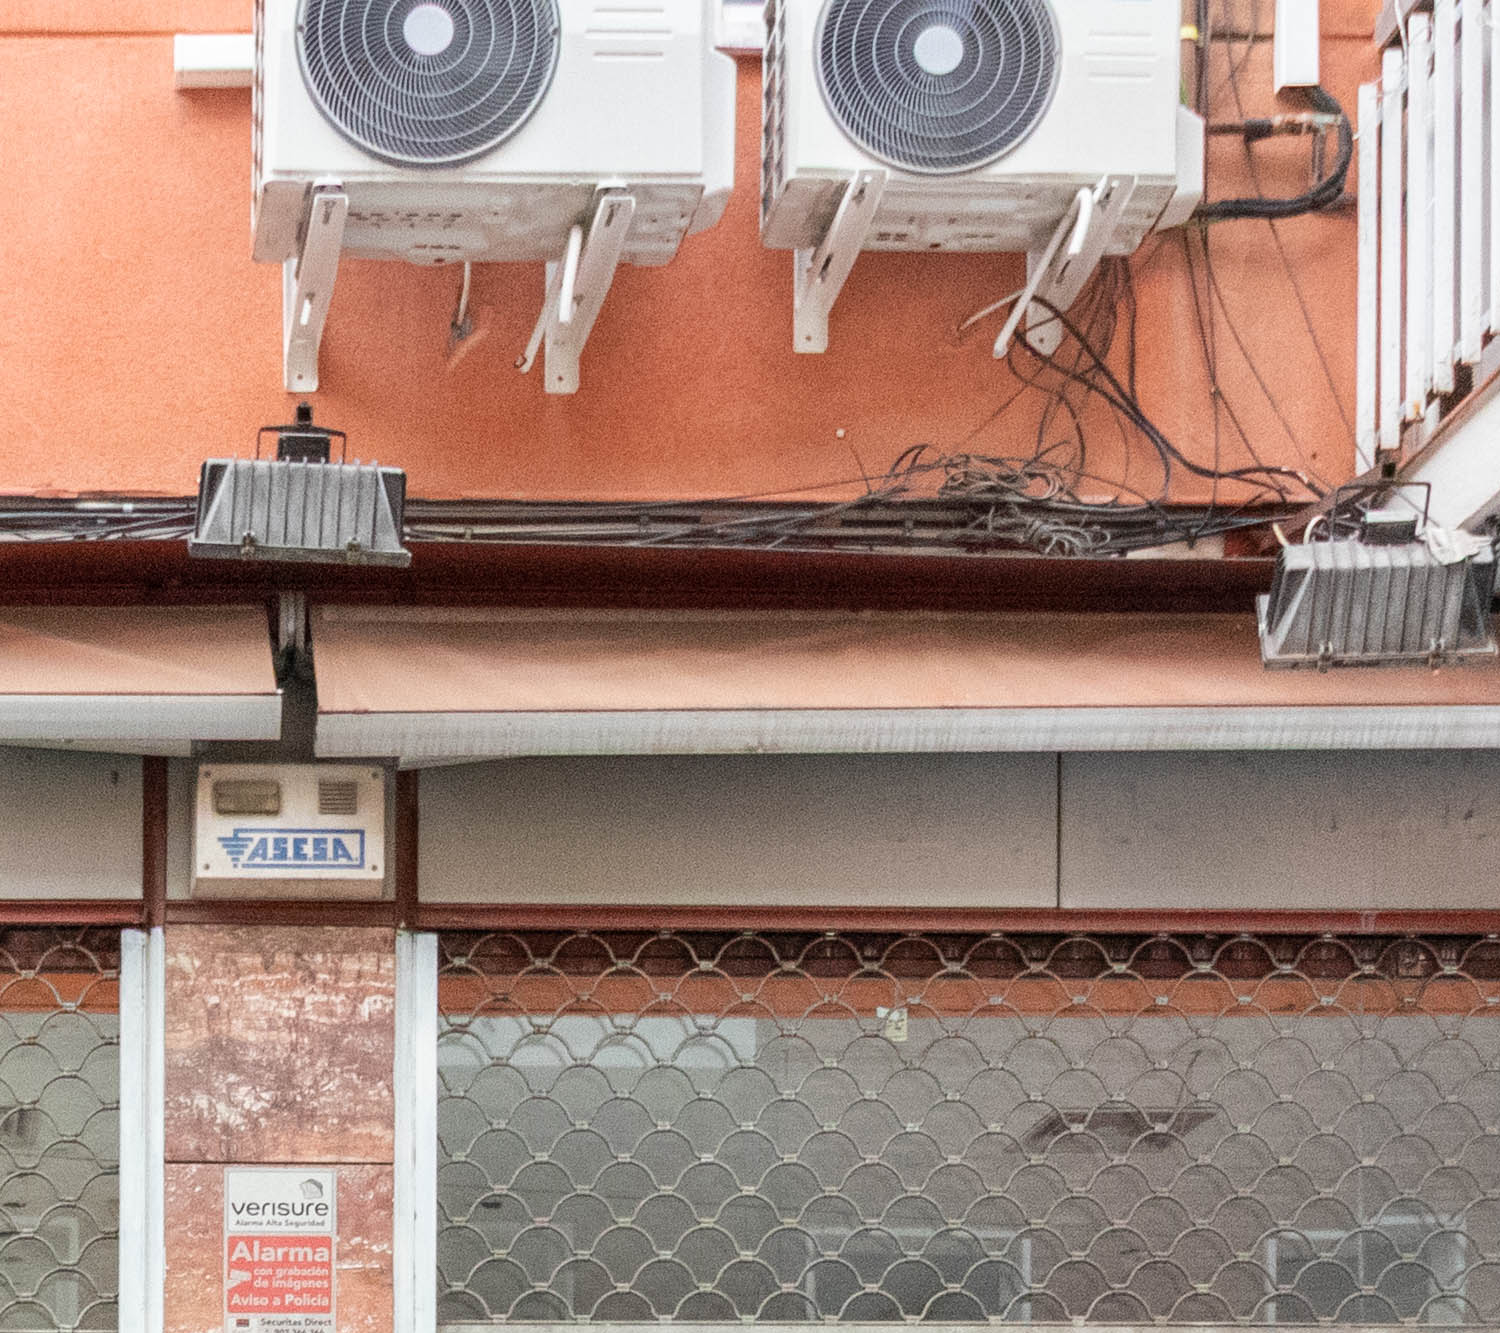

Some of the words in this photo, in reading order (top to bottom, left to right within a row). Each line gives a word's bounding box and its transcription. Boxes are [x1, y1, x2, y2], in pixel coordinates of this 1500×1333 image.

[231, 1202, 329, 1216] verisure
[284, 1219, 325, 1228] Seguridad
[231, 1240, 329, 1262] Alarma
[254, 1278, 269, 1288] de
[272, 1278, 329, 1291] imágenes
[231, 1293, 269, 1306] Aviso
[272, 1297, 281, 1306] a
[284, 1293, 329, 1306] Policía
[260, 1318, 302, 1327] Securitas
[304, 1318, 332, 1327] Direct
